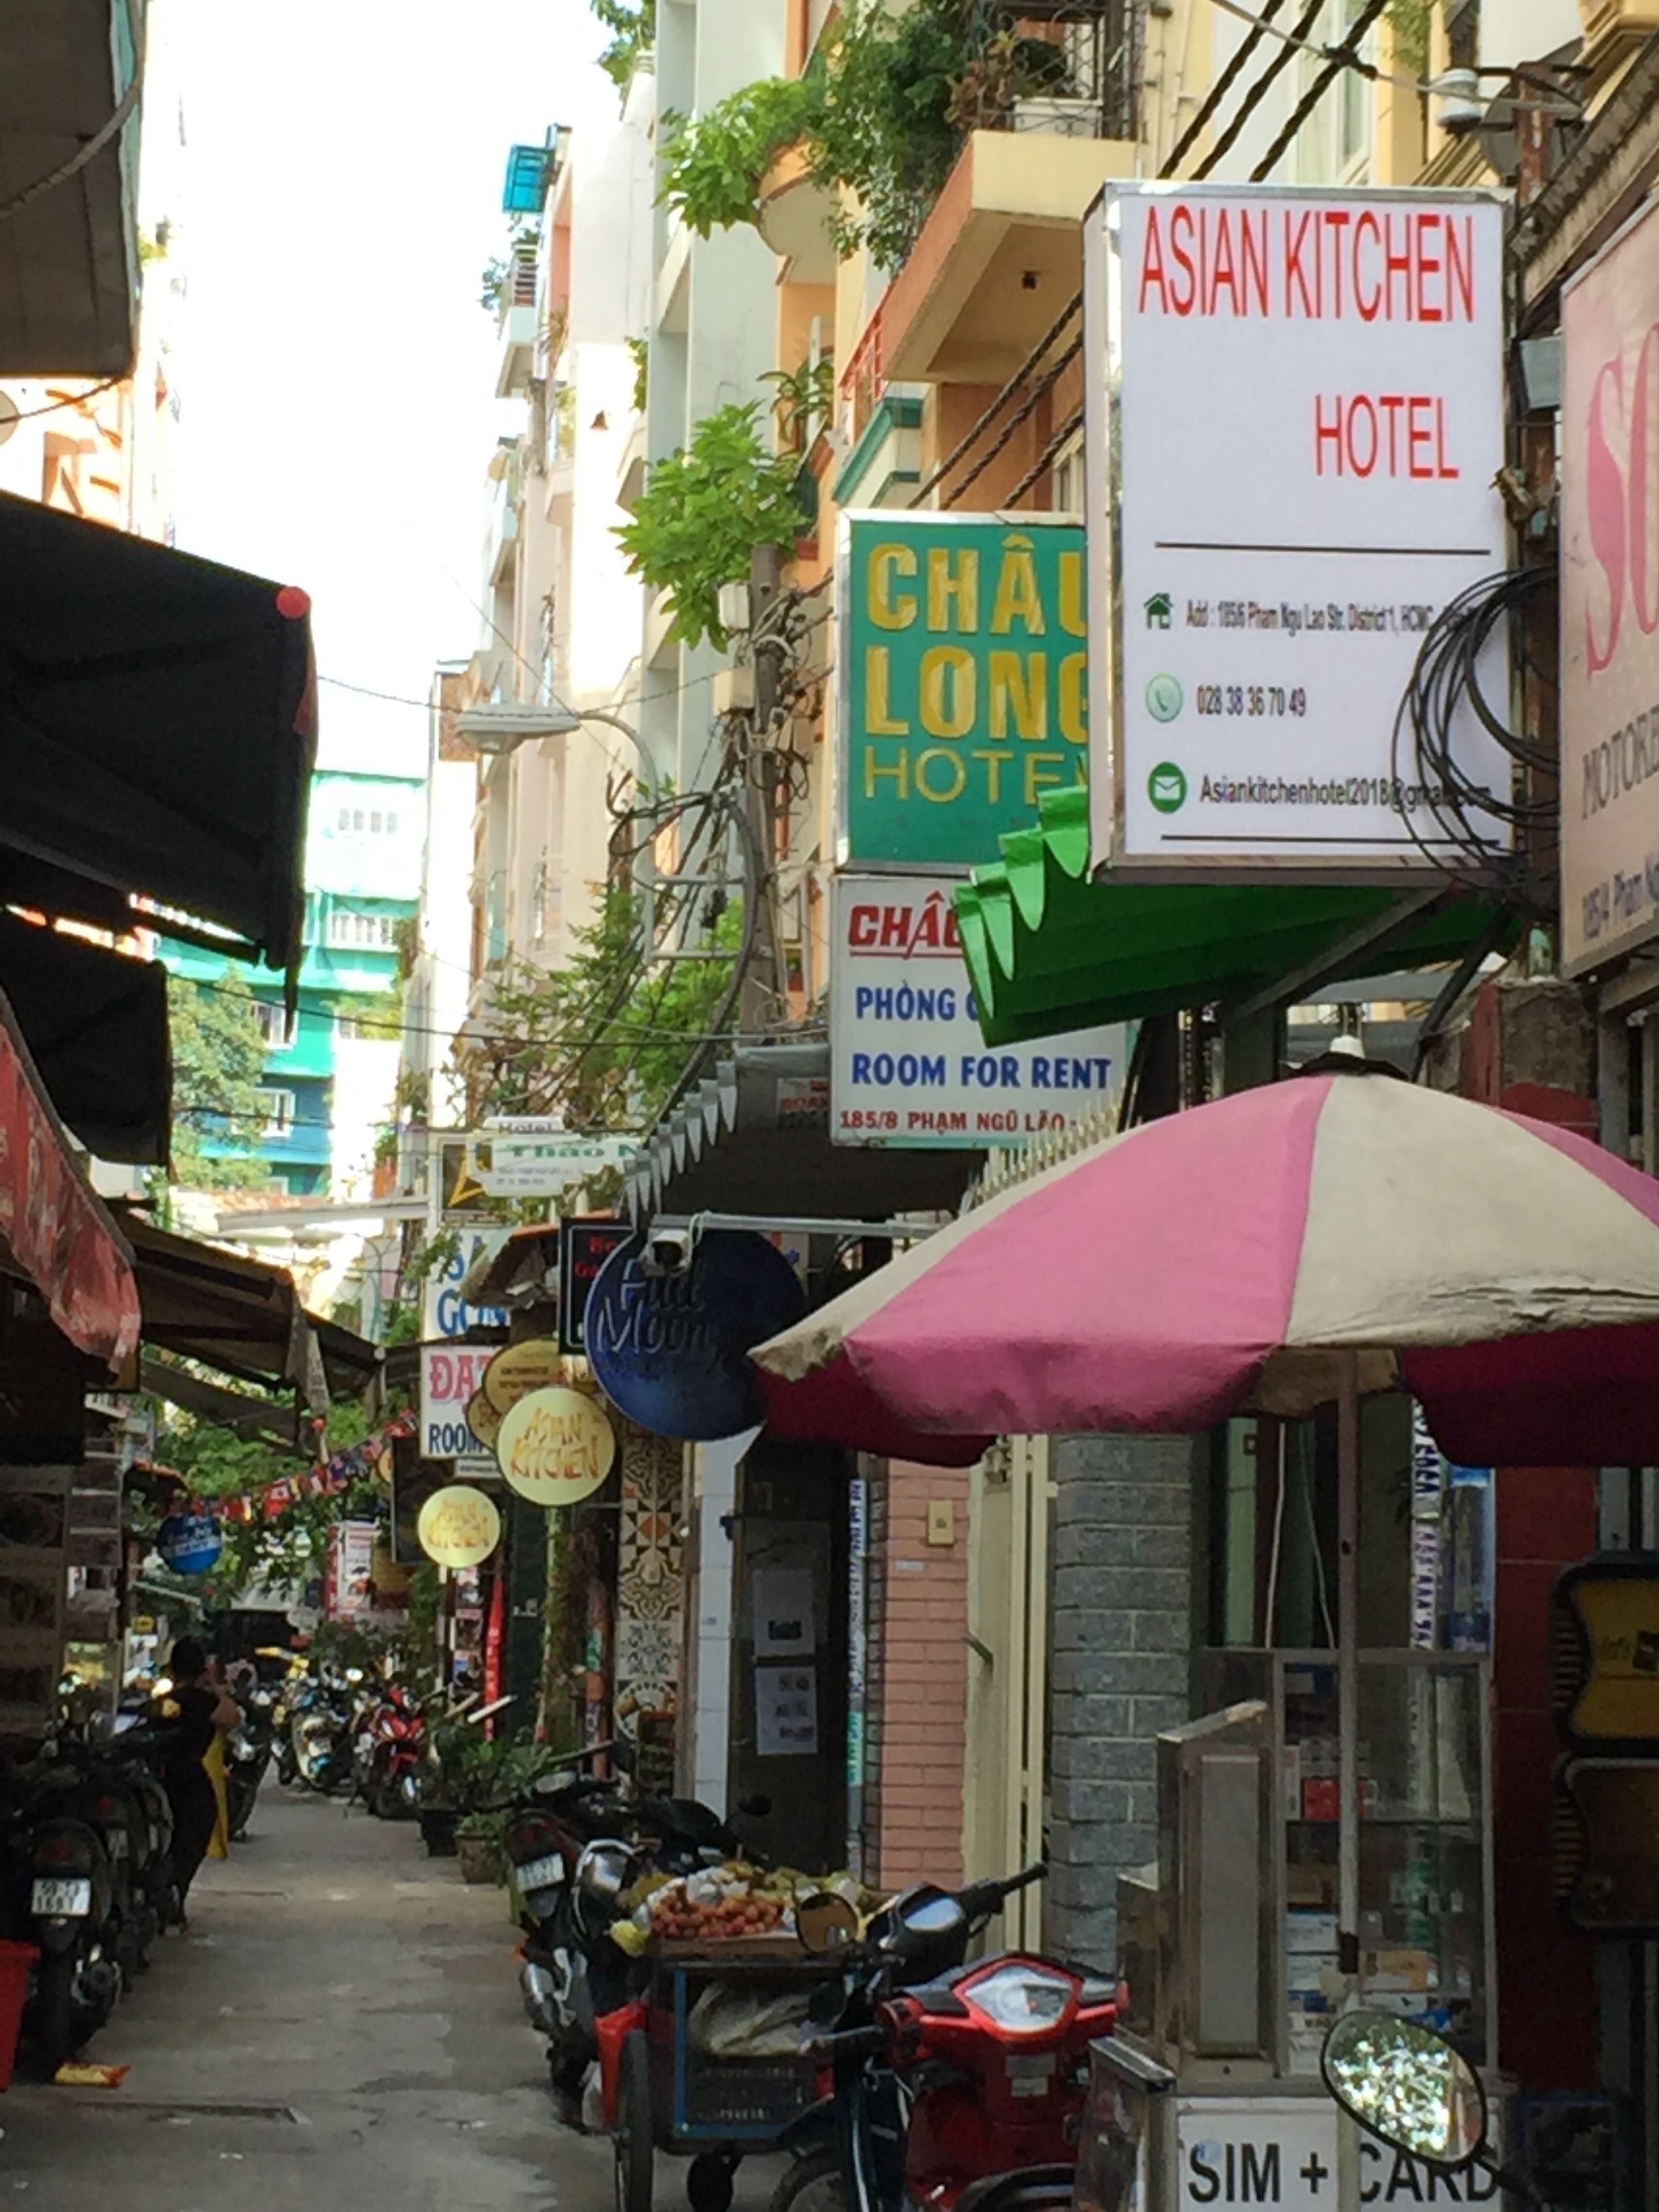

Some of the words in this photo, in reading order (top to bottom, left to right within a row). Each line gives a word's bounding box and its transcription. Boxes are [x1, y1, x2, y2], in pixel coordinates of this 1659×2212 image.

[1139, 205, 1268, 318] ASIAN
[1285, 209, 1473, 323] KITCHEN
[1315, 394, 1459, 478] HOTEL
[1197, 684, 1222, 715] 028
[1227, 686, 1244, 716] 38
[1248, 686, 1265, 716] 36
[1268, 687, 1286, 717] 70
[1289, 687, 1306, 717] 49
[863, 745, 1088, 805] HOTE
[856, 979, 956, 1022] PHÒNG
[852, 1052, 946, 1086] ROOM
[961, 1056, 1020, 1088] FOR
[1031, 1057, 1111, 1090] RENT
[840, 1110, 899, 1130] 185/8
[1187, 2142, 1282, 2203] SIM
